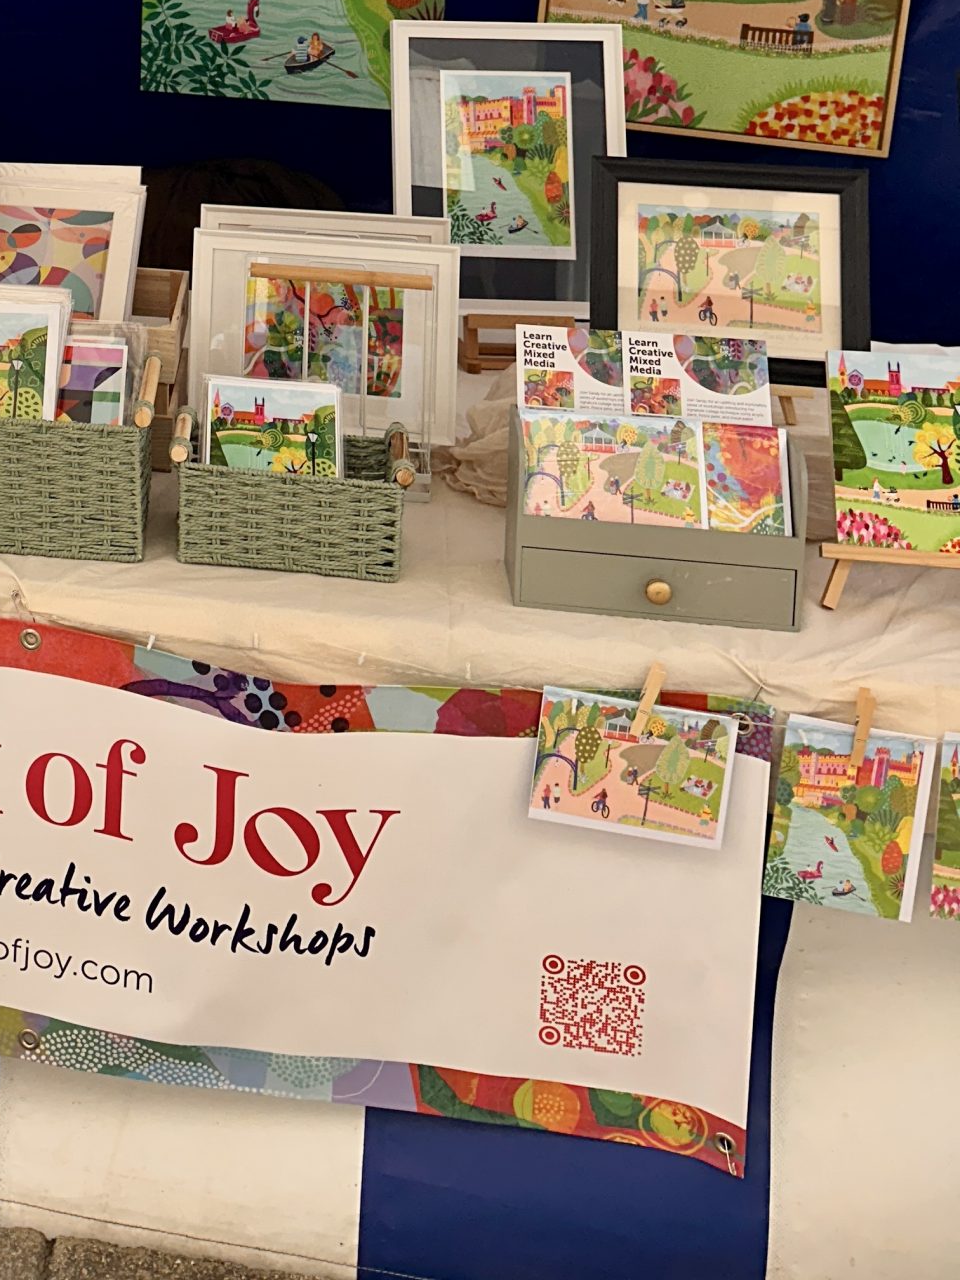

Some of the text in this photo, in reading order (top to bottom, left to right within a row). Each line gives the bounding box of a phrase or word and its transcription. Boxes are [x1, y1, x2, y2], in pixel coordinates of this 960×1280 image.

[523, 330, 552, 341] Learn
[523, 340, 568, 351] Creative
[628, 337, 658, 348] Learn
[524, 349, 555, 359] Mixed
[628, 346, 674, 358] Creative
[524, 358, 555, 368] Media
[629, 355, 661, 366] Mixed
[629, 365, 662, 375] Media
[25, 738, 147, 842] of
[173, 764, 401, 907] Joy
[144, 886, 376, 967] Workshops
